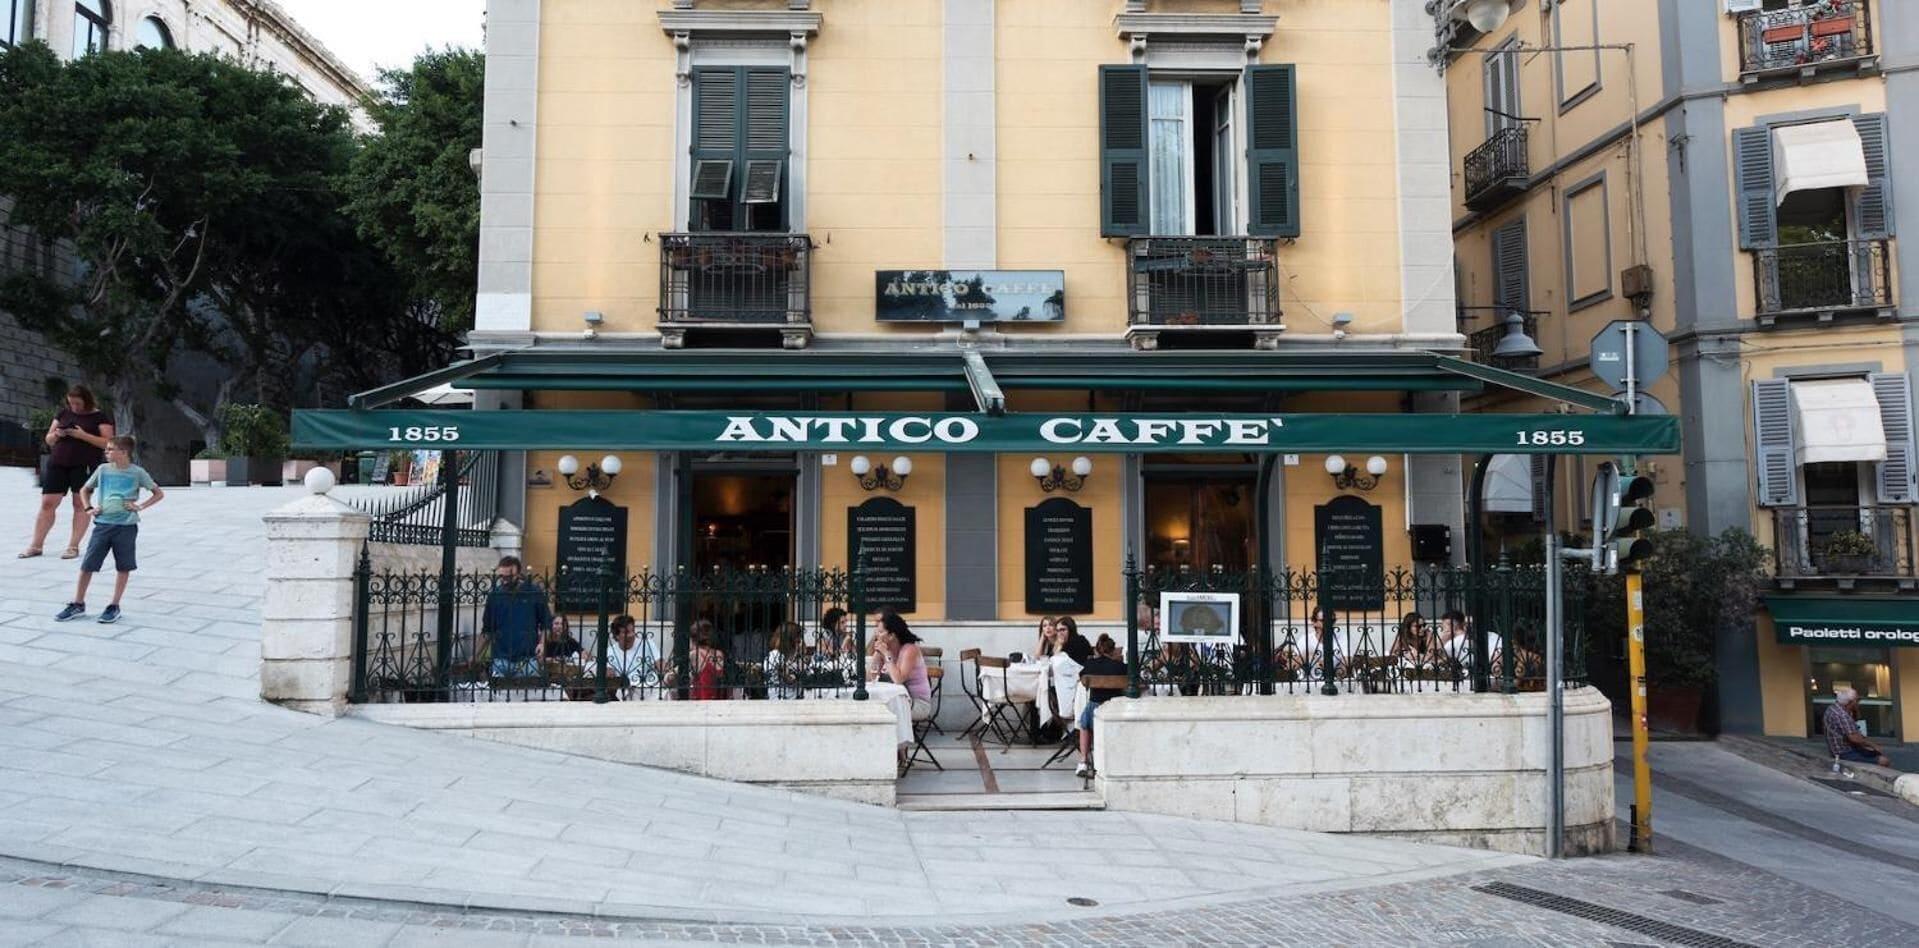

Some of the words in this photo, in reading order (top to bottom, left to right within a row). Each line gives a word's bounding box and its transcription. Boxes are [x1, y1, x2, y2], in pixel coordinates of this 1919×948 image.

[884, 282, 970, 297] ANTICO
[388, 426, 460, 442] 1855
[715, 416, 979, 443] ANTICO
[1516, 430, 1586, 447] 1855
[1790, 627, 1861, 639] Paoletti
